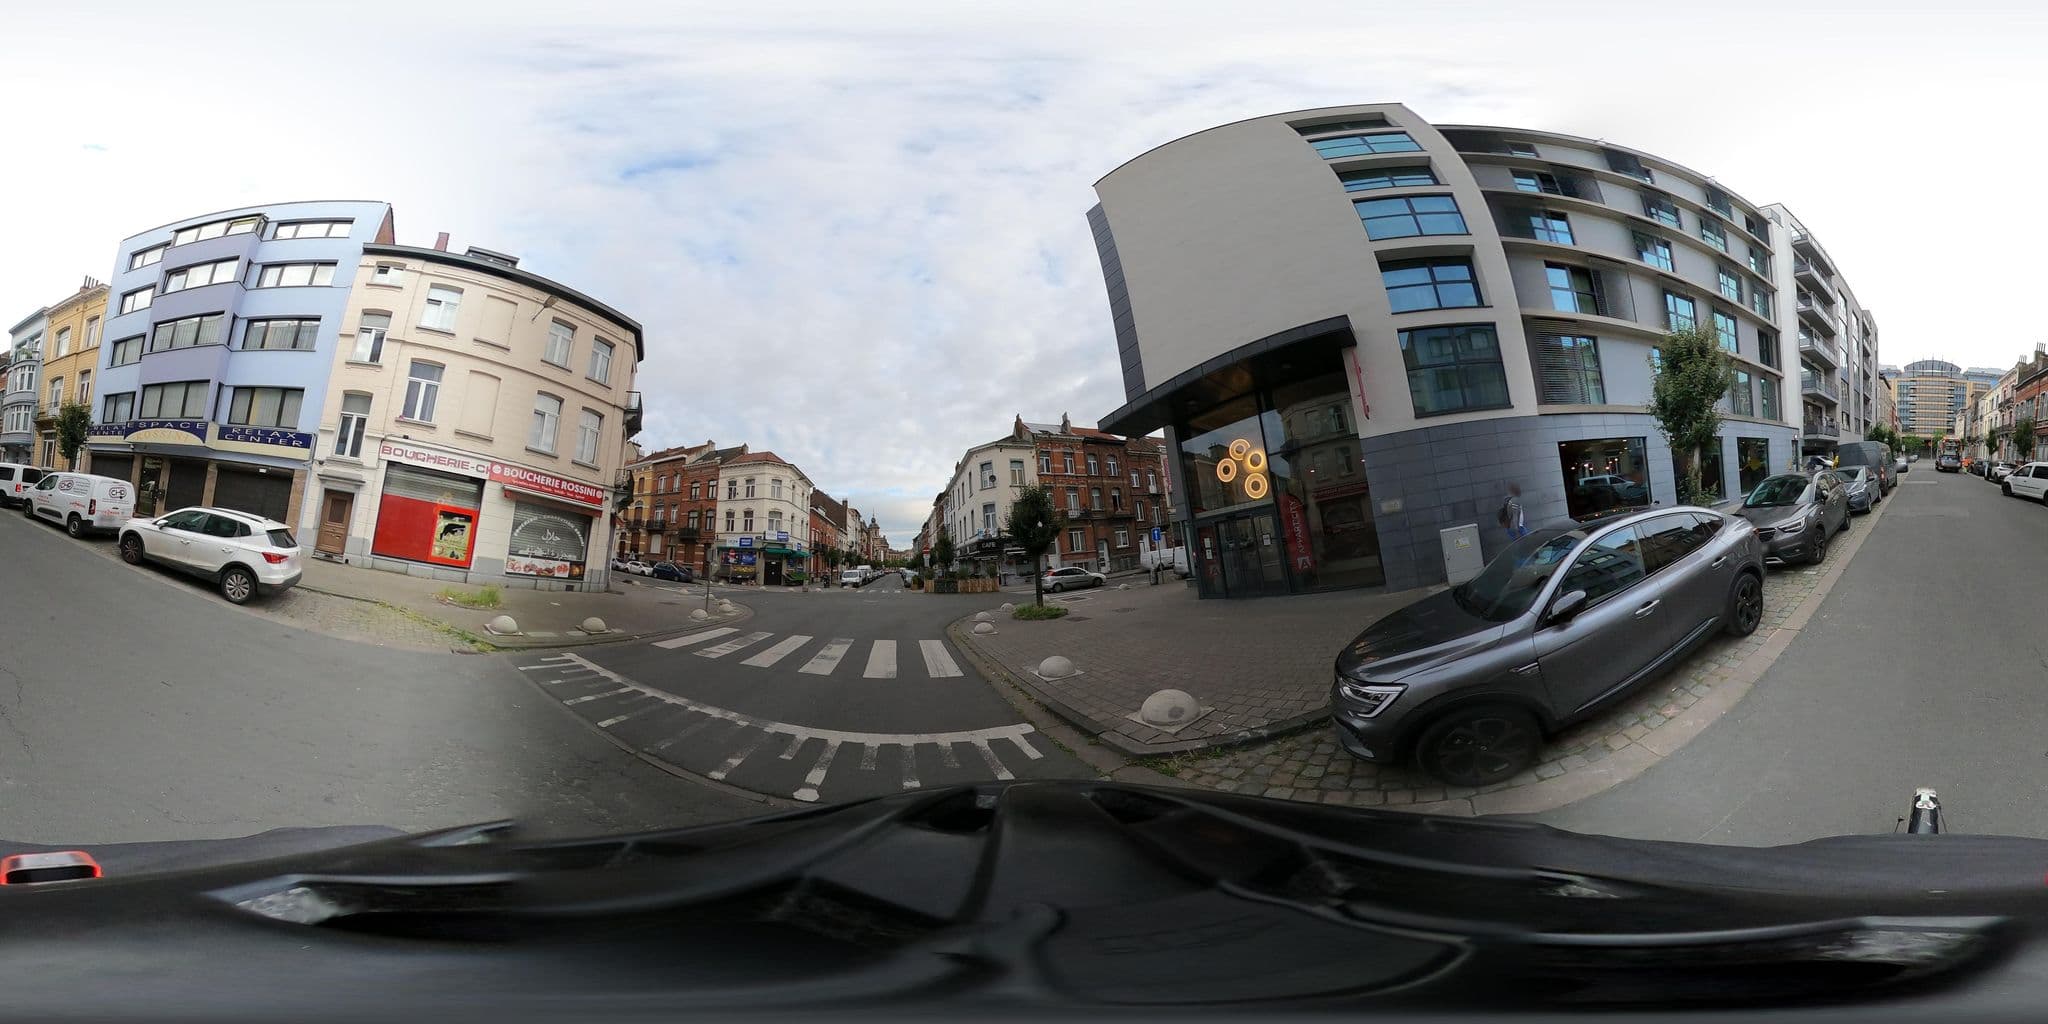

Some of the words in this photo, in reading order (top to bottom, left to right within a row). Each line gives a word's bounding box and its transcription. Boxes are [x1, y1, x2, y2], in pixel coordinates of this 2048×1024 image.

[232, 427, 296, 438] RELAX
[224, 434, 303, 446] CENTER
[503, 467, 560, 488] BOUCHERIE
[560, 480, 596, 497] ROSSINI
